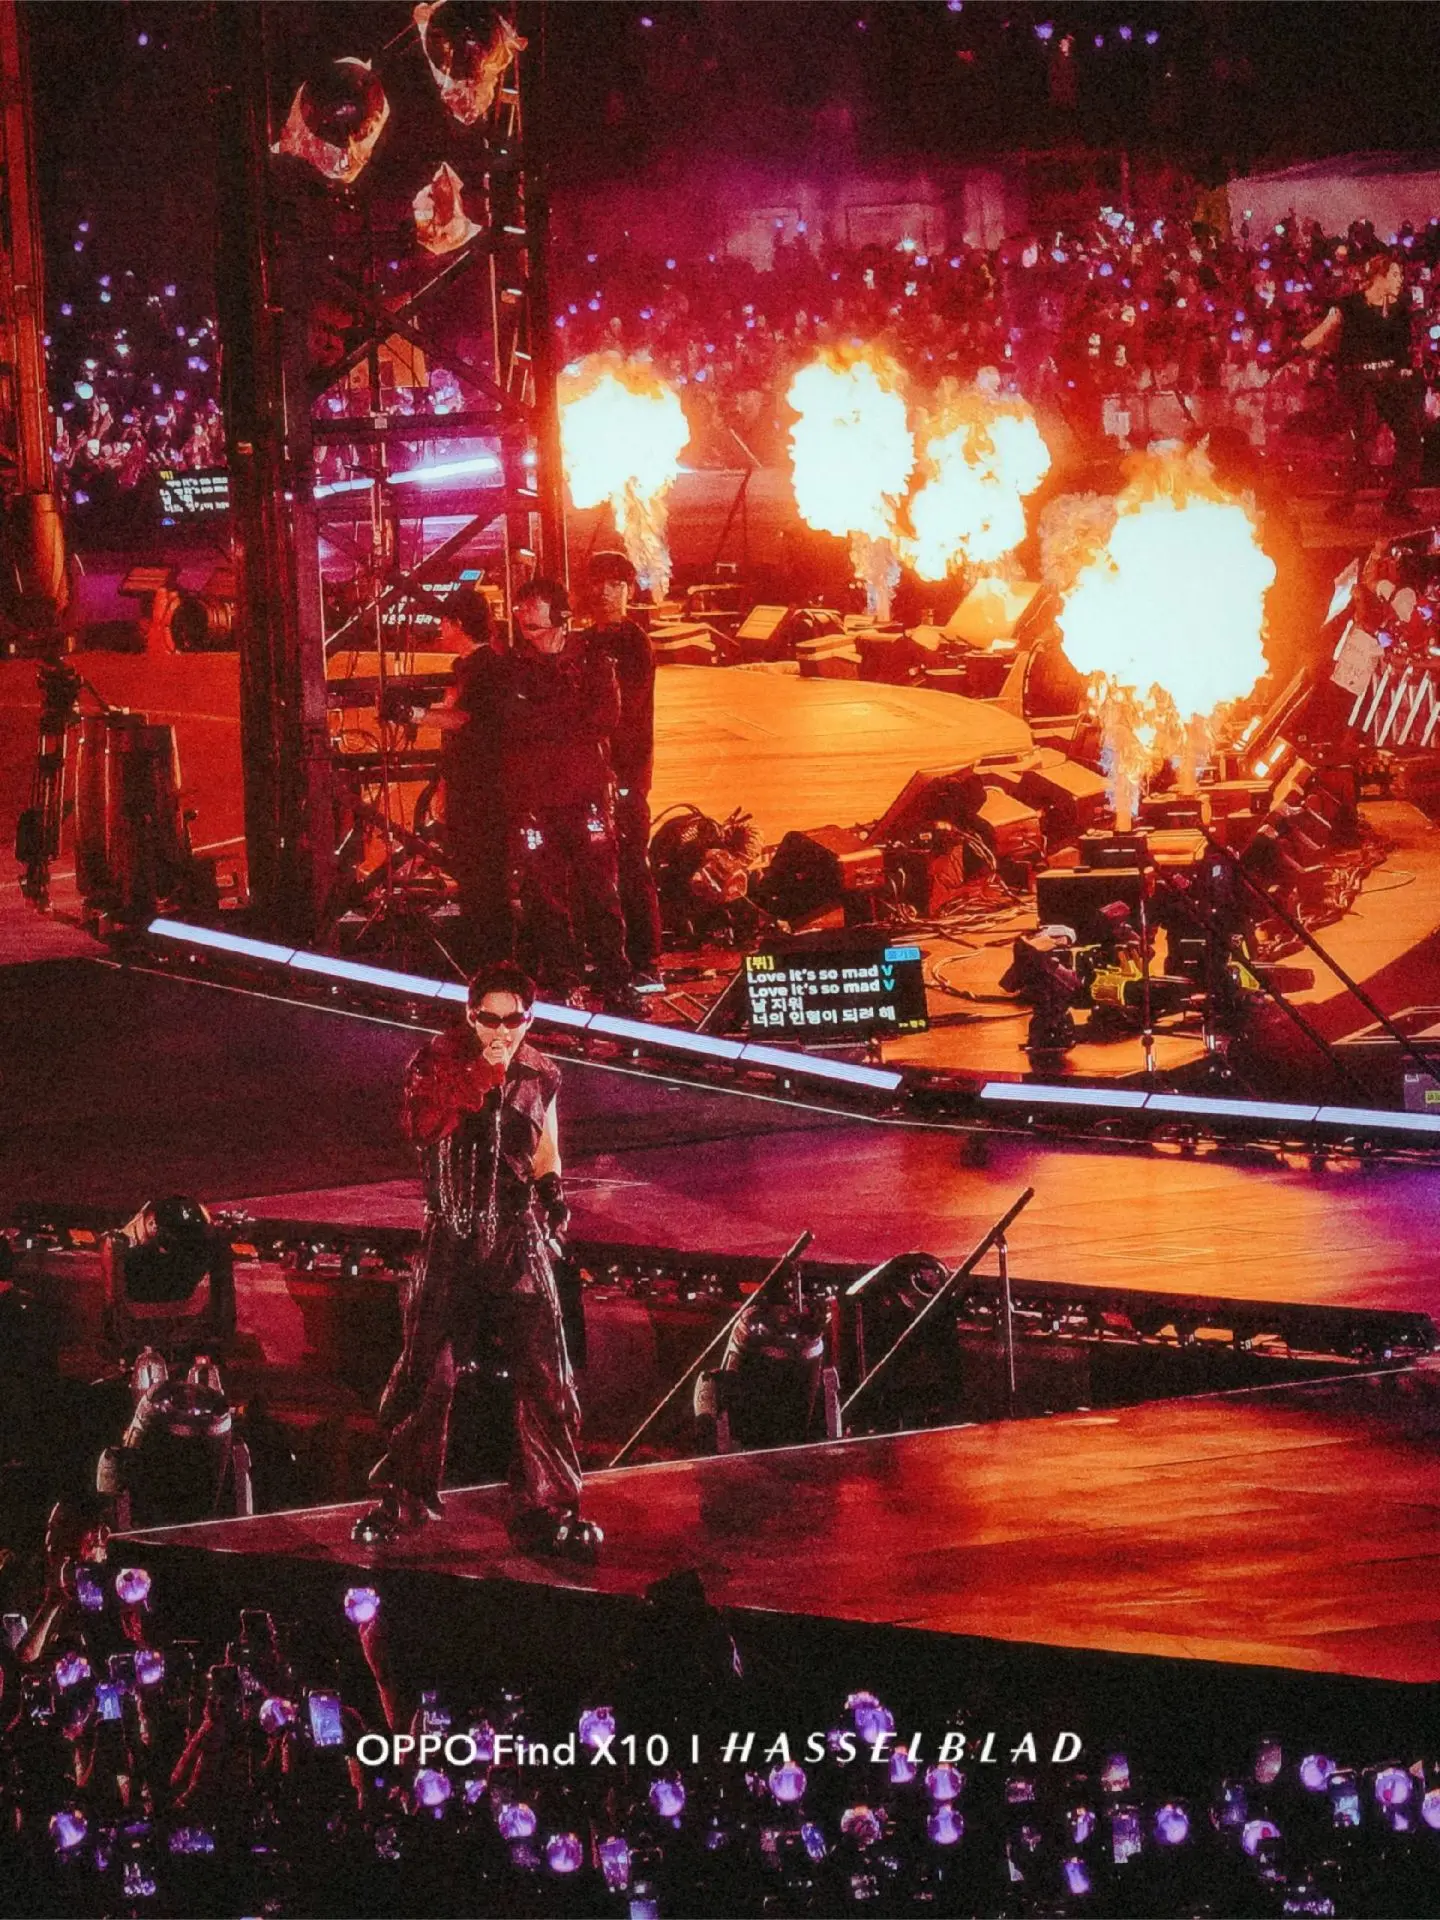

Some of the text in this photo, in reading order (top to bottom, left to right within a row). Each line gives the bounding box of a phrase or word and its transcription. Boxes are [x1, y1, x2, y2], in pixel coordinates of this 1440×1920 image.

[747, 971, 786, 984] Love
[819, 969, 838, 980] so
[842, 965, 879, 978] mad
[749, 985, 788, 998] Love
[821, 984, 840, 995] so
[843, 979, 880, 994] mad
[752, 1011, 785, 1027] 너의
